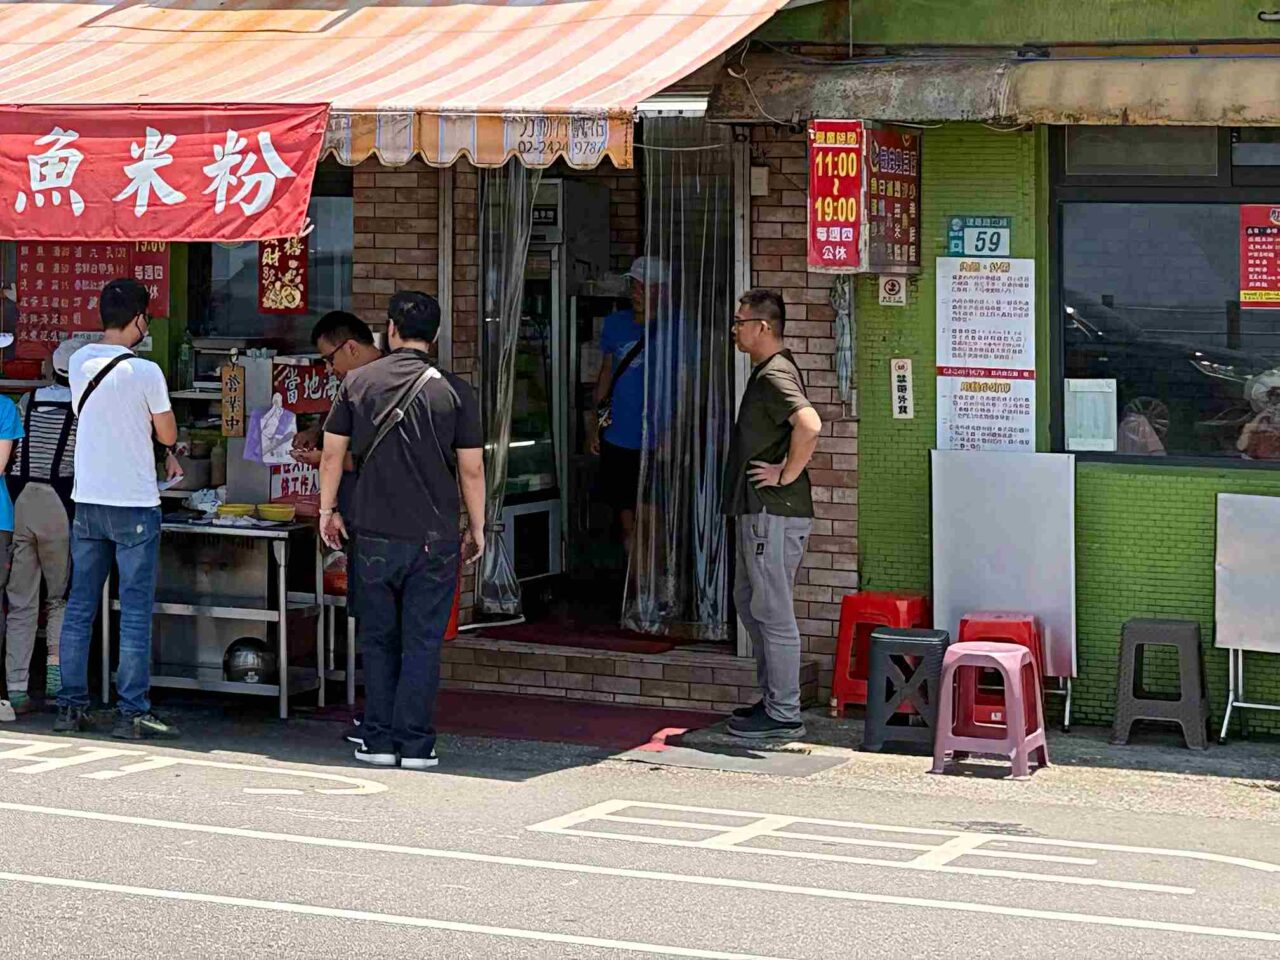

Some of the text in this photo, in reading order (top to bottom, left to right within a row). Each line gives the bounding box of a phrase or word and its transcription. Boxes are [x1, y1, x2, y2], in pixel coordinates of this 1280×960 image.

[815, 151, 857, 177] 11:00
[815, 196, 857, 223] 19:00
[822, 245, 848, 260] 公休
[975, 231, 1001, 252] 59
[225, 374, 241, 431] 營業中
